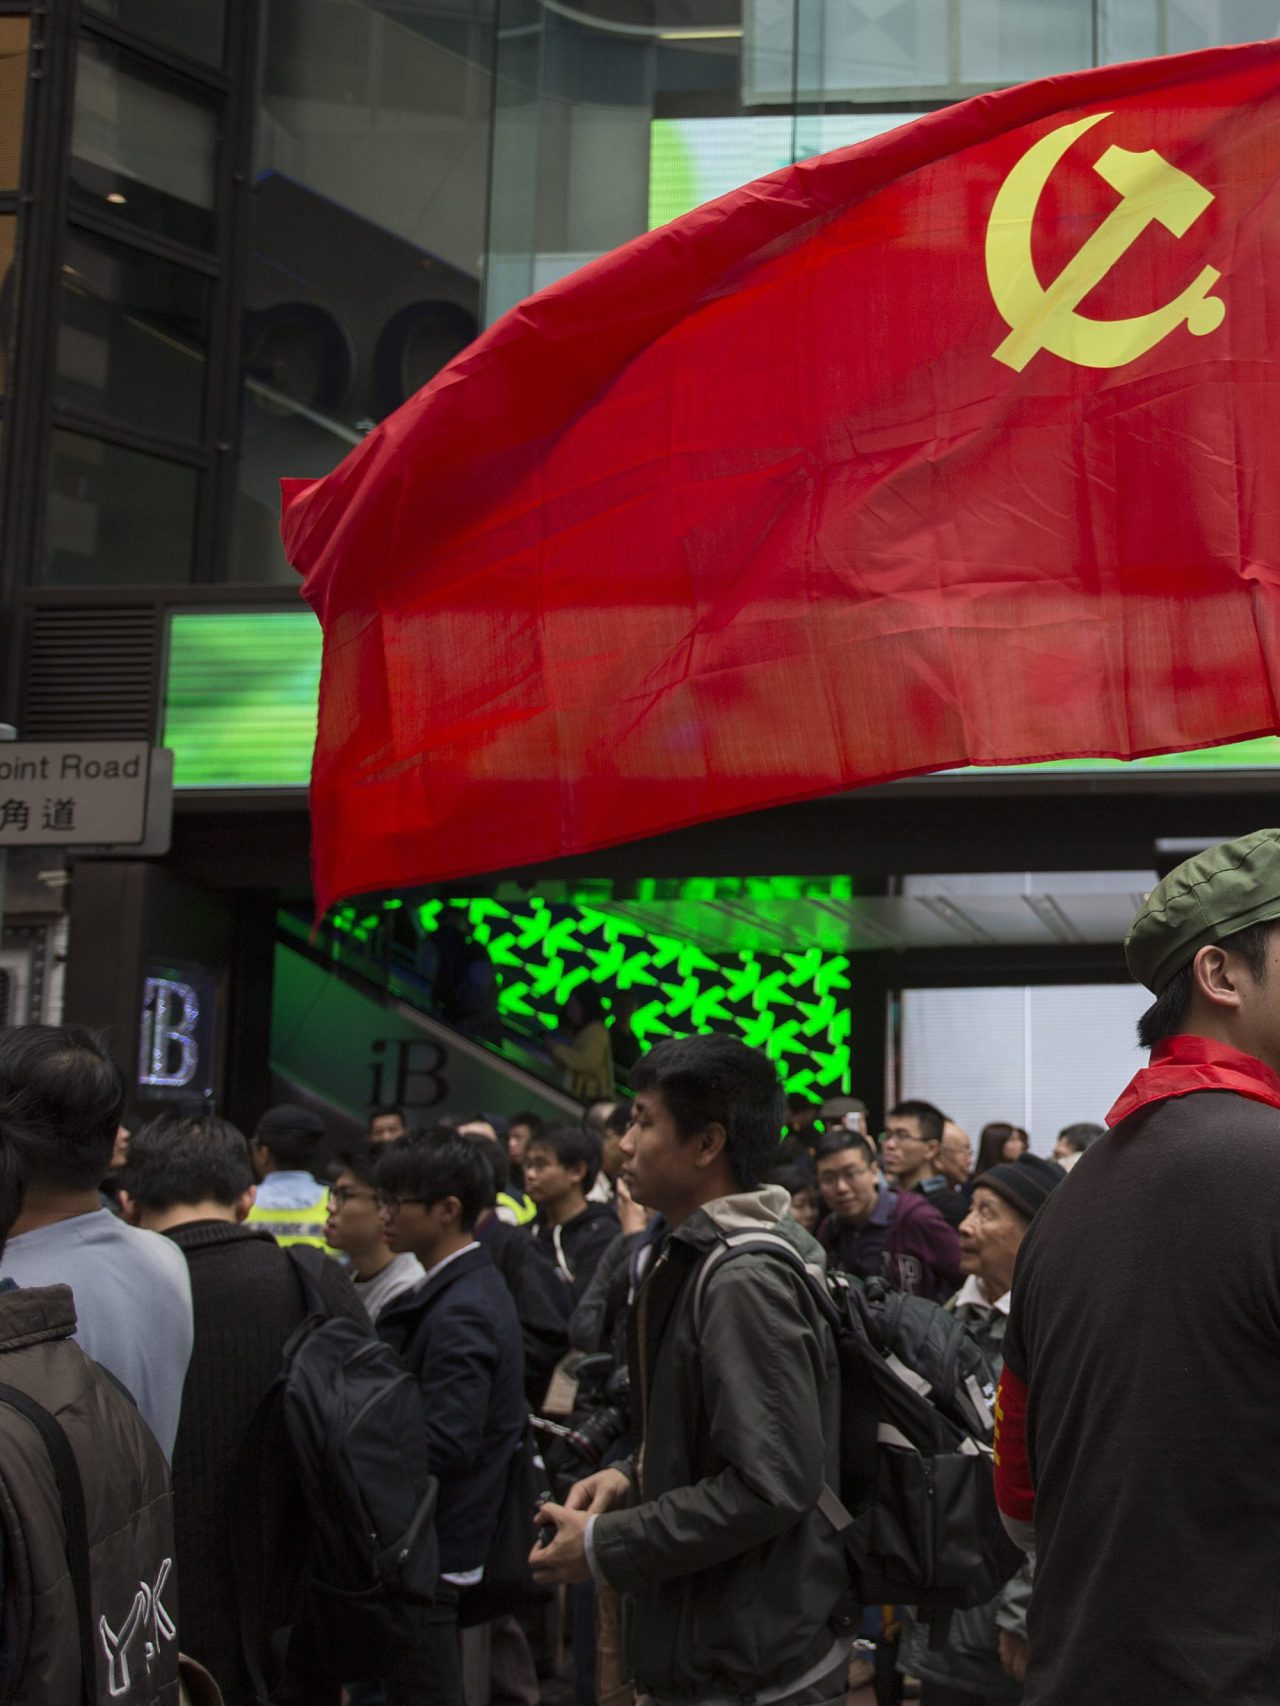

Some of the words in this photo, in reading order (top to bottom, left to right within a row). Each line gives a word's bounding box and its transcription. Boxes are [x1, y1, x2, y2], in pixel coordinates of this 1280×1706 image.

[61, 753, 140, 779] Road
[0, 798, 76, 831] 角道
[371, 1039, 449, 1106] iB
